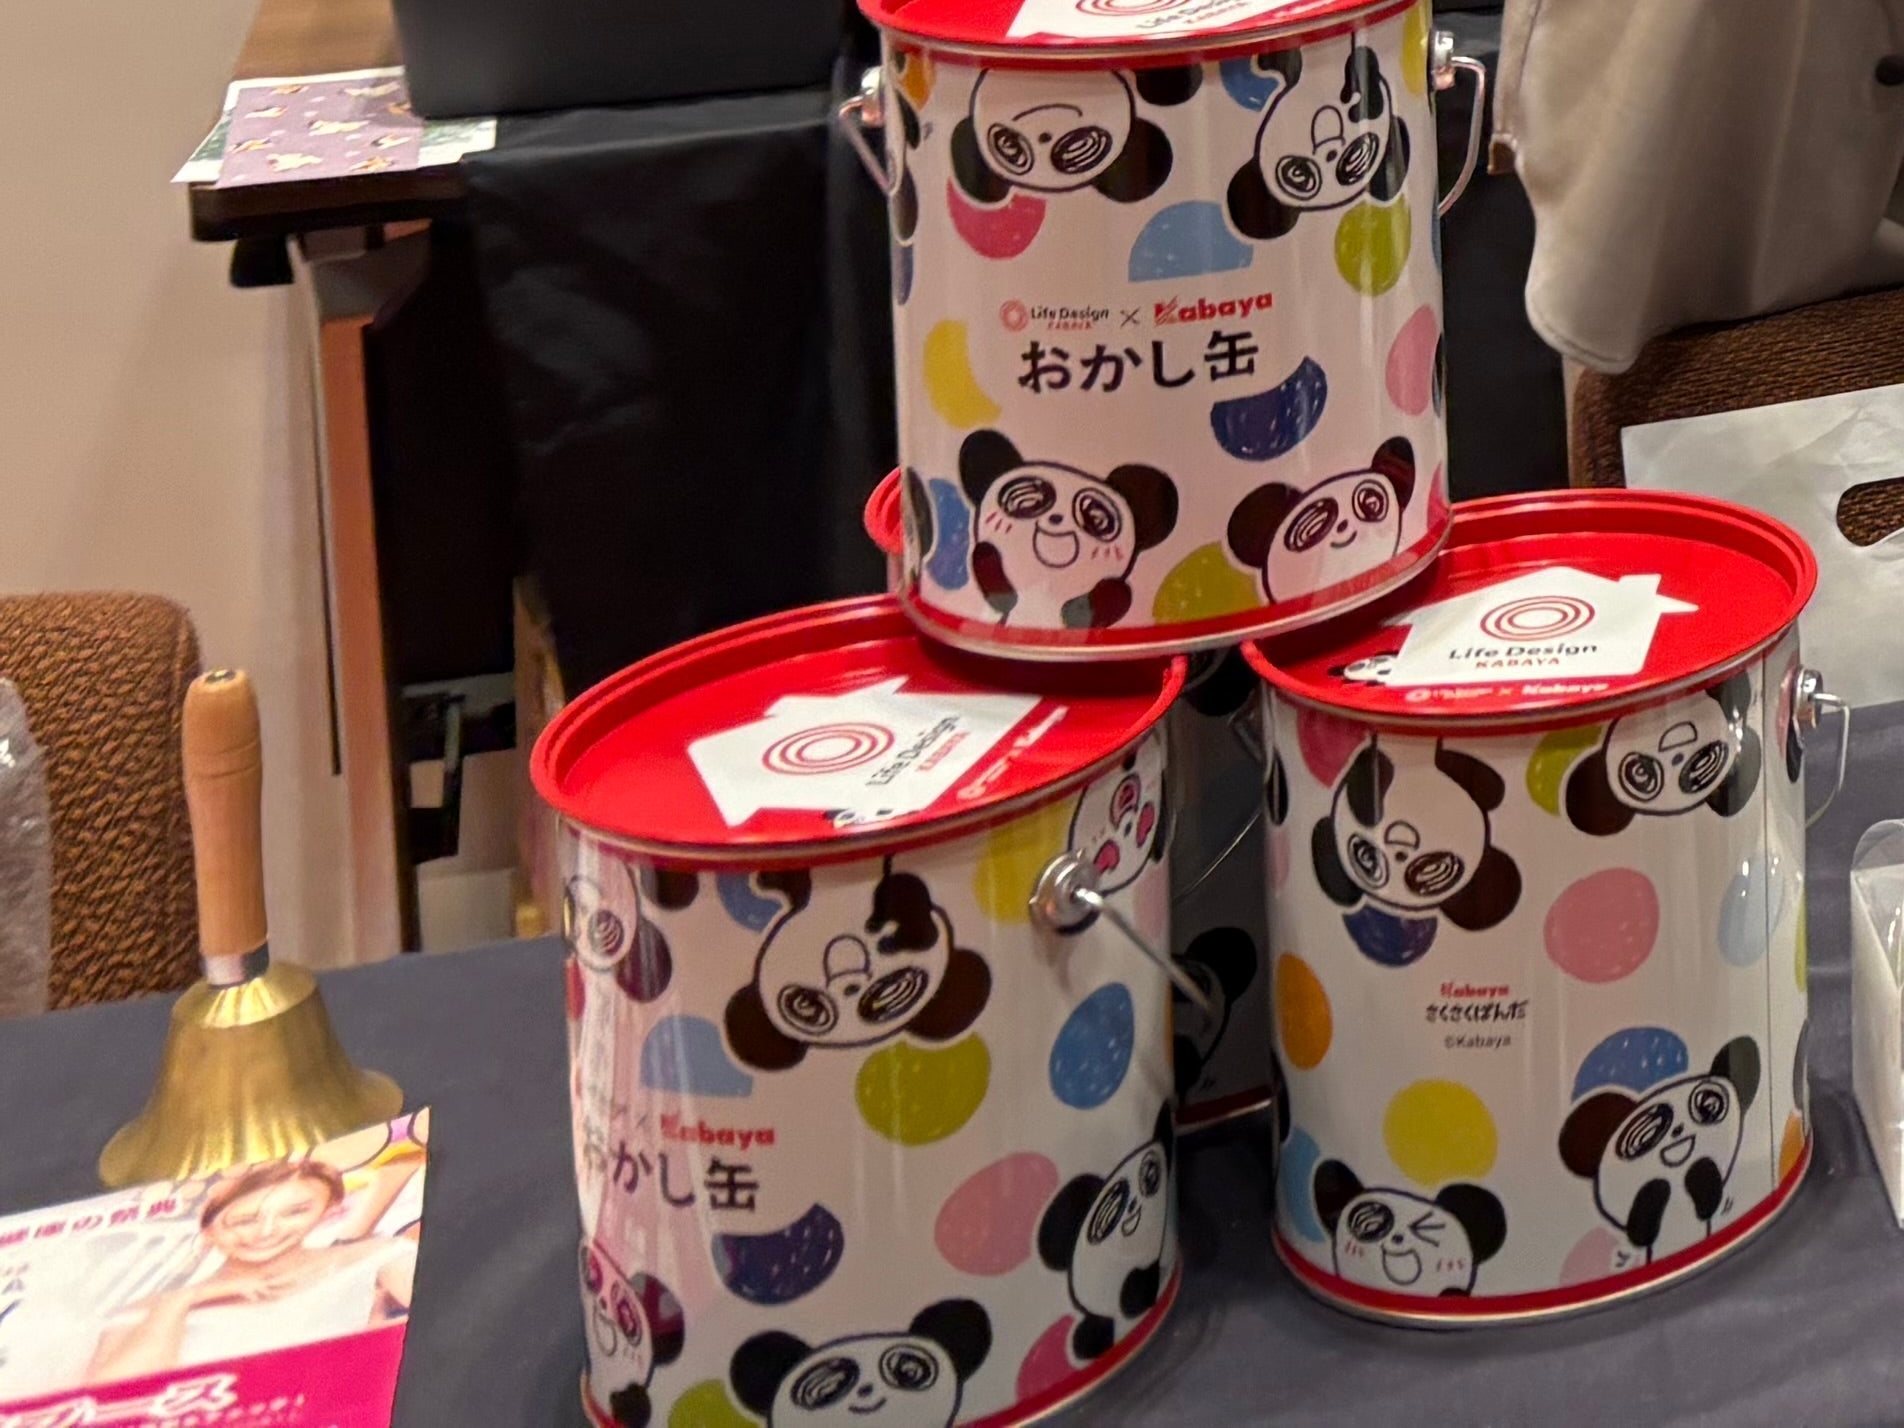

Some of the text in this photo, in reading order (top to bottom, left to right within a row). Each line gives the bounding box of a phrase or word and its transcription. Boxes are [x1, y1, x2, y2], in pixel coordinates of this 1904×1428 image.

[1030, 305, 1056, 319] Life
[1059, 305, 1109, 322] Design
[1154, 292, 1273, 326] Kabaya
[1018, 329, 1259, 394] おかし缶
[1449, 643, 1598, 660] Life Design
[661, 1113, 774, 1150] Kabaya
